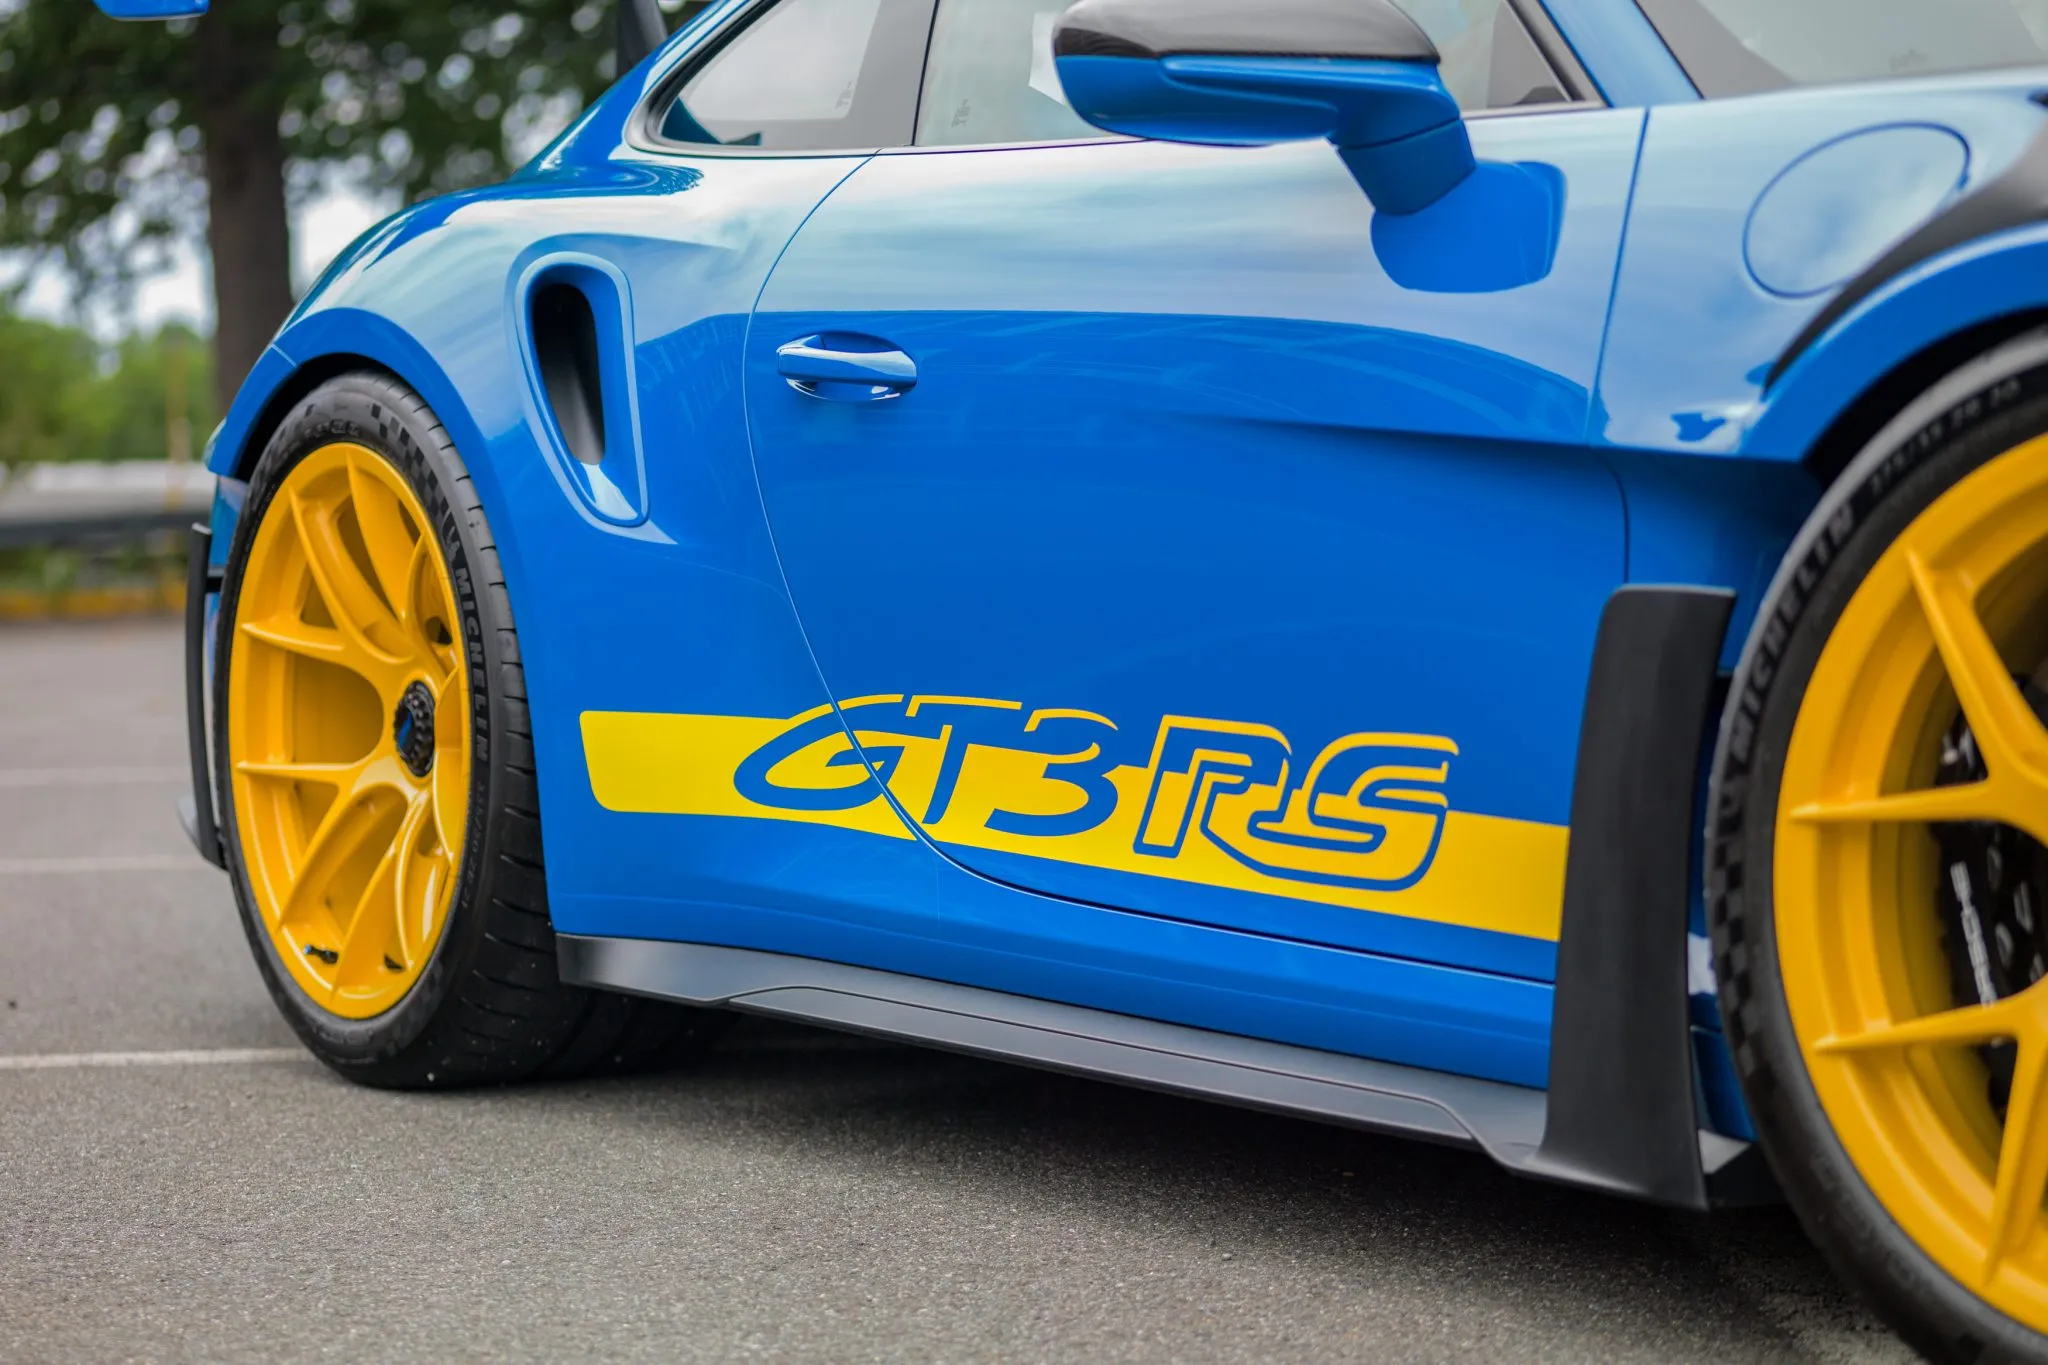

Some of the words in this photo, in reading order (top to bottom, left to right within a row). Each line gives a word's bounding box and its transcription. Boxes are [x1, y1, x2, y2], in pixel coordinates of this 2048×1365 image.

[455, 567, 490, 762] MICHELIN
[1731, 500, 1854, 764] MICHELIN
[733, 694, 1119, 838] GT3
[1132, 714, 1460, 893] RS
